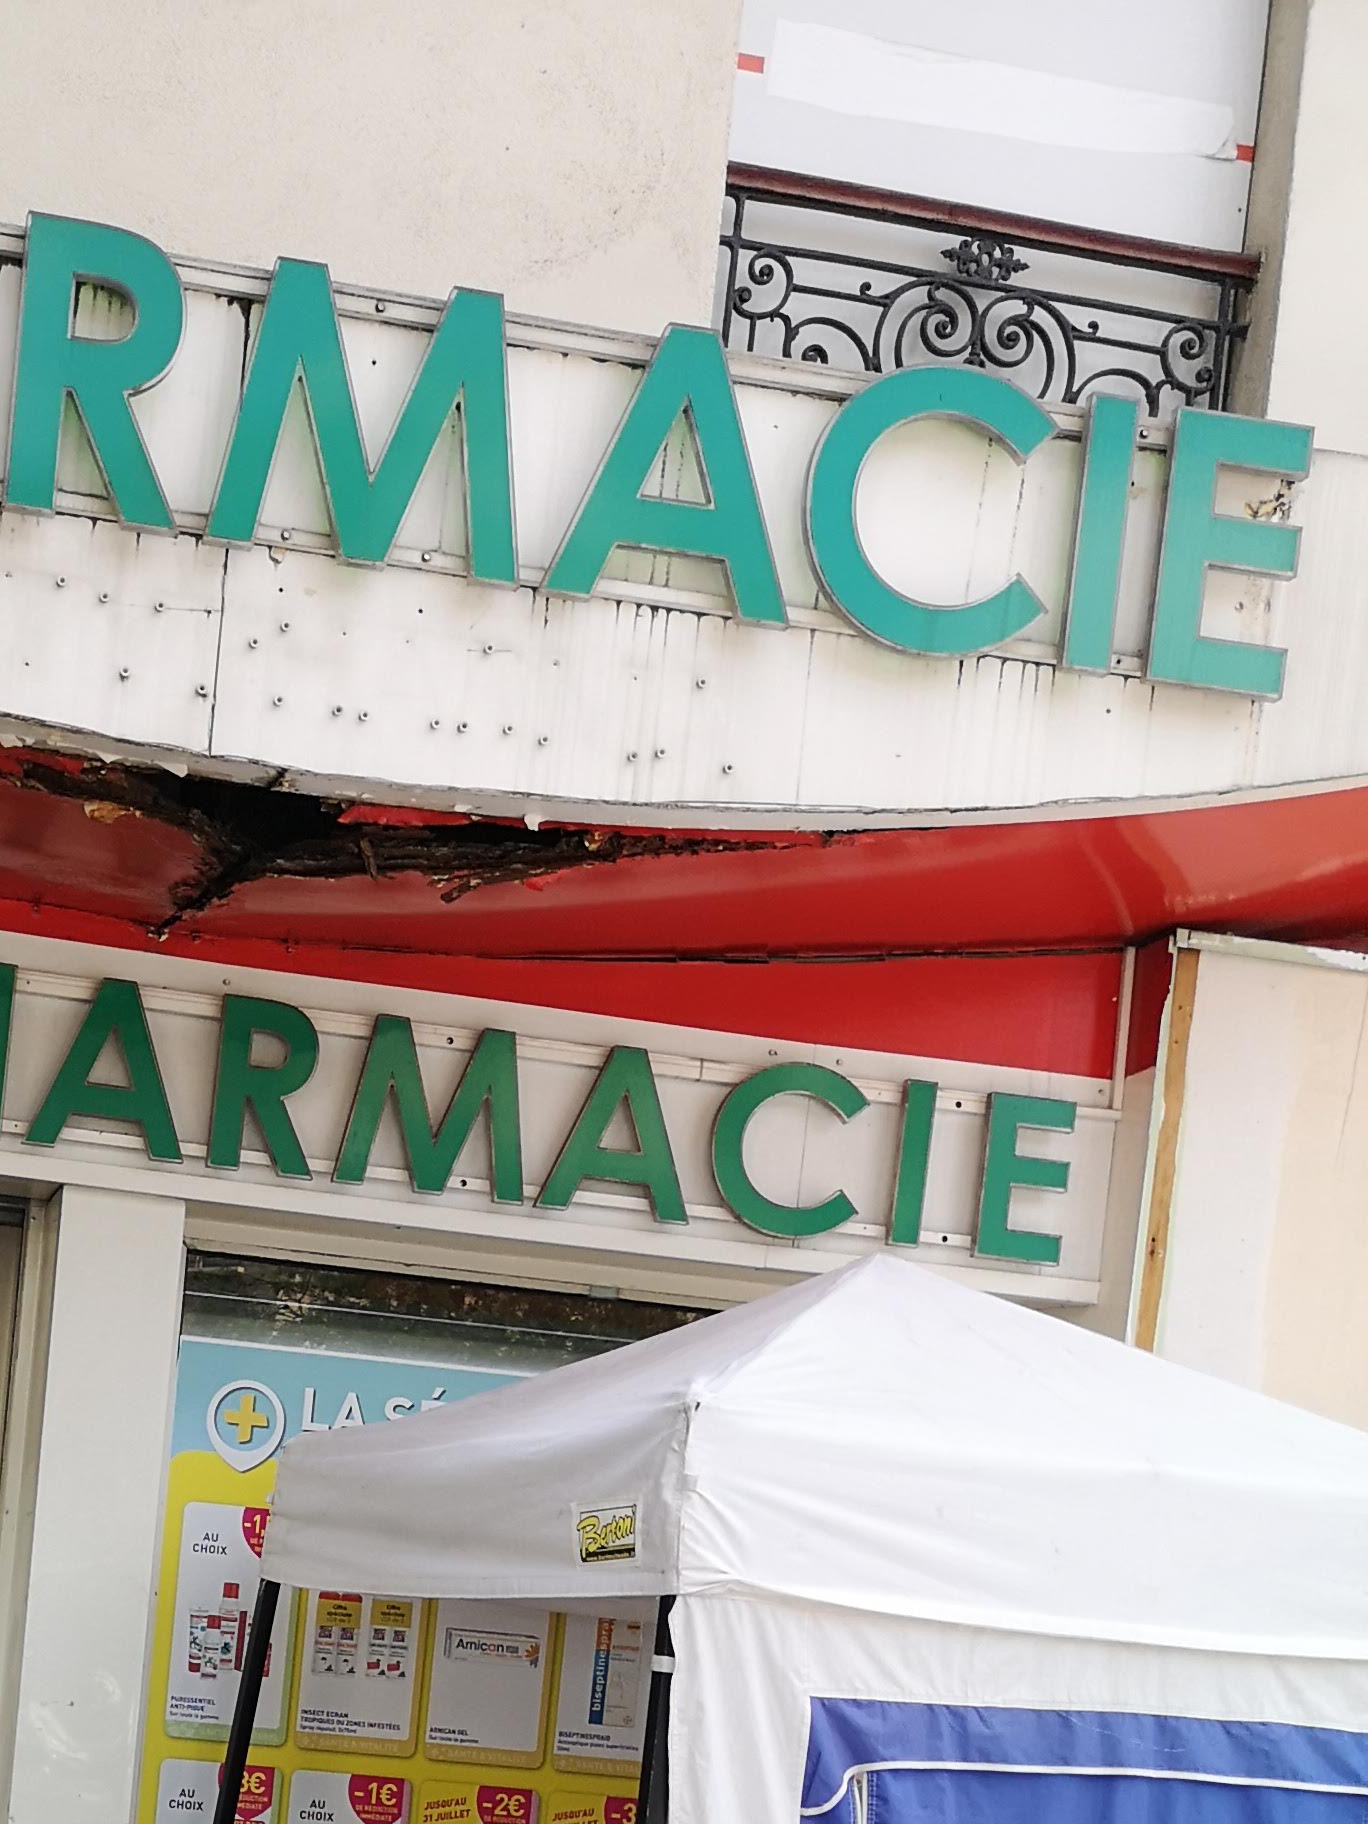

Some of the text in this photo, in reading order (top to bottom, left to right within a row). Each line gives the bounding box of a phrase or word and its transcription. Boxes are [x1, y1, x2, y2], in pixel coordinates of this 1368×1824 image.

[301, 1387, 365, 1431] LA
[203, 1532, 219, 1543] AU
[192, 1543, 228, 1556] CHOIX
[179, 1788, 195, 1798] AU
[168, 1799, 204, 1811] CHOIX
[309, 1799, 326, 1809] AU
[423, 1796, 467, 1811] JUSQU'AU
[482, 1793, 526, 1817] -2€
[299, 1810, 334, 1822] CHOIX
[434, 1809, 471, 1822] JUILLET
[552, 1808, 595, 1821] JUSQU'AU
